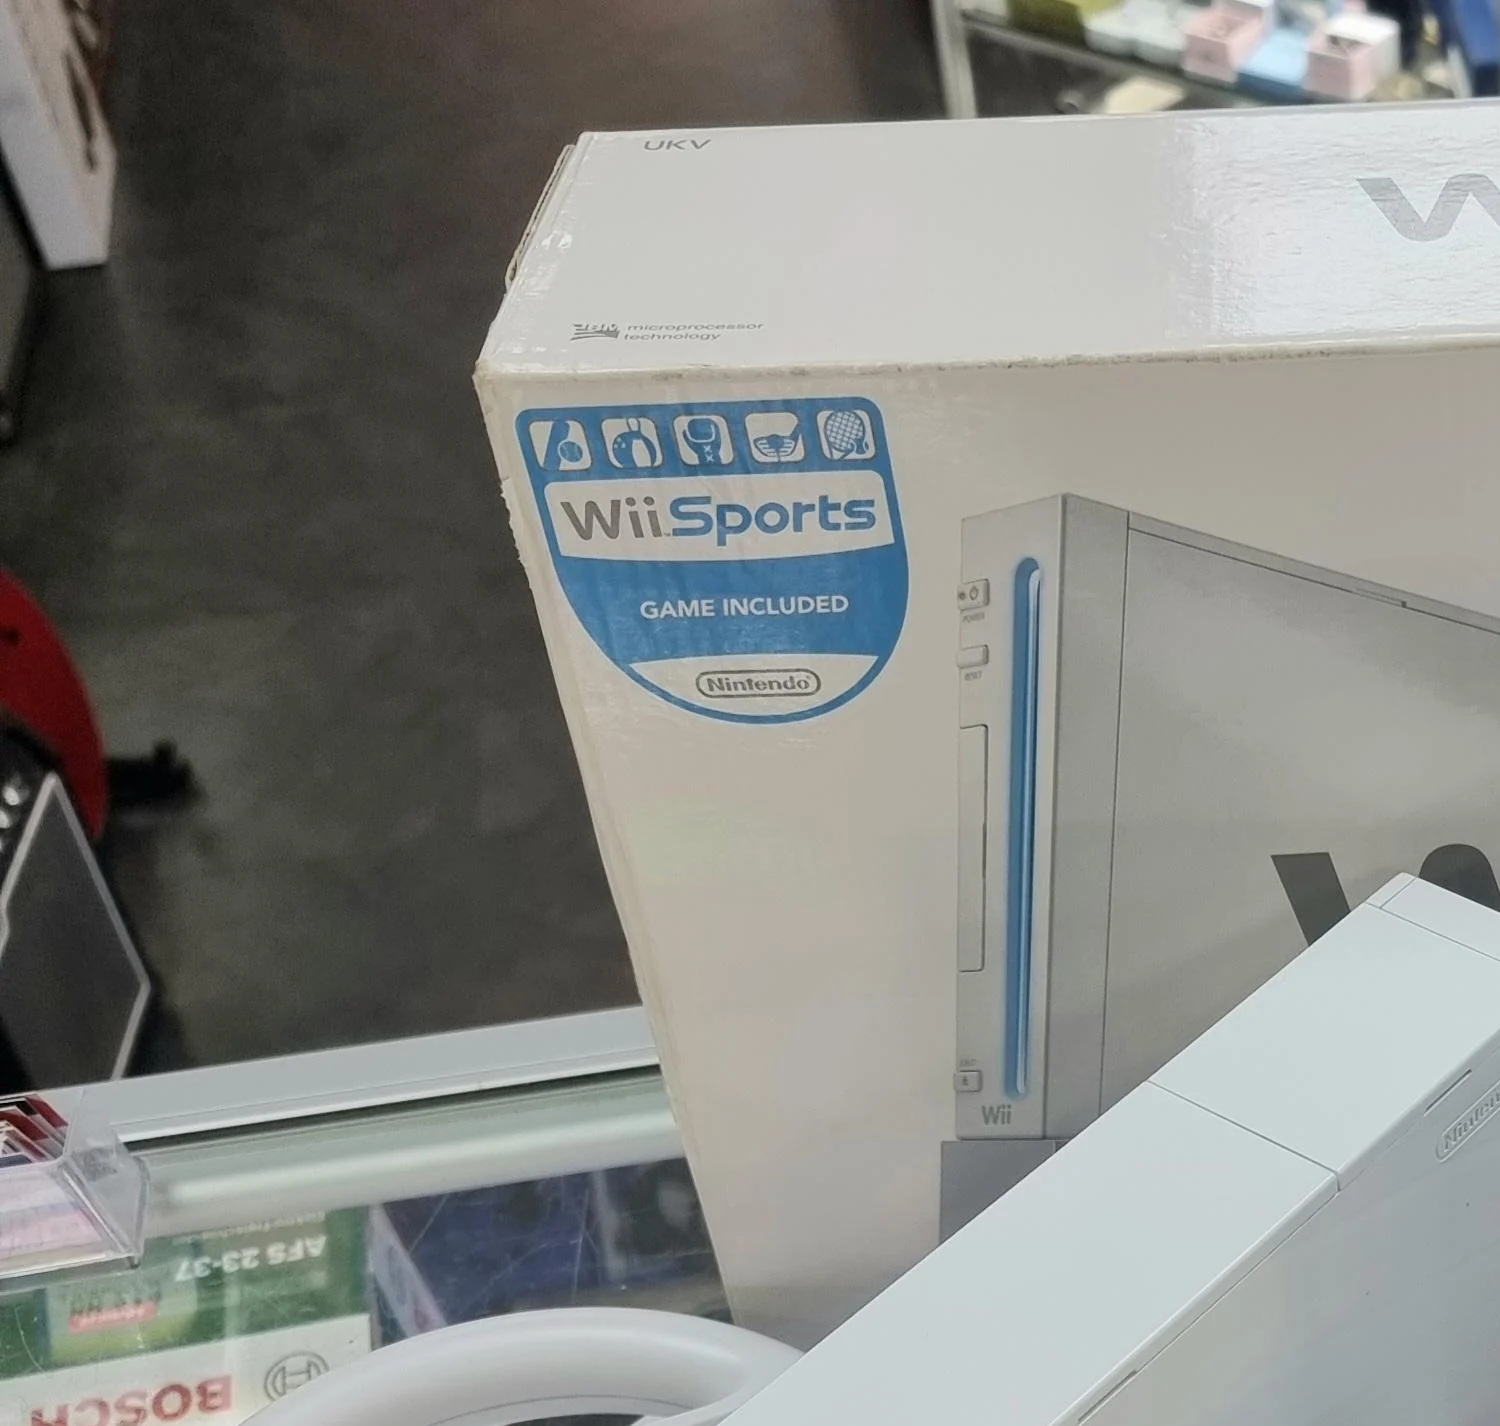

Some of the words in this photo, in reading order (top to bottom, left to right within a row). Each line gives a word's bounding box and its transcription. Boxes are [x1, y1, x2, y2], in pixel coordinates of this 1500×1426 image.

[643, 138, 711, 153] UKV
[624, 332, 721, 341] technology
[627, 322, 764, 332] microprocessor
[671, 494, 876, 547] Sports
[640, 599, 717, 621] GAME
[723, 595, 849, 618] INCLUDED
[705, 672, 816, 696] Nintendo
[982, 1104, 1012, 1125] Wii
[266, 1233, 327, 1266] AFS
